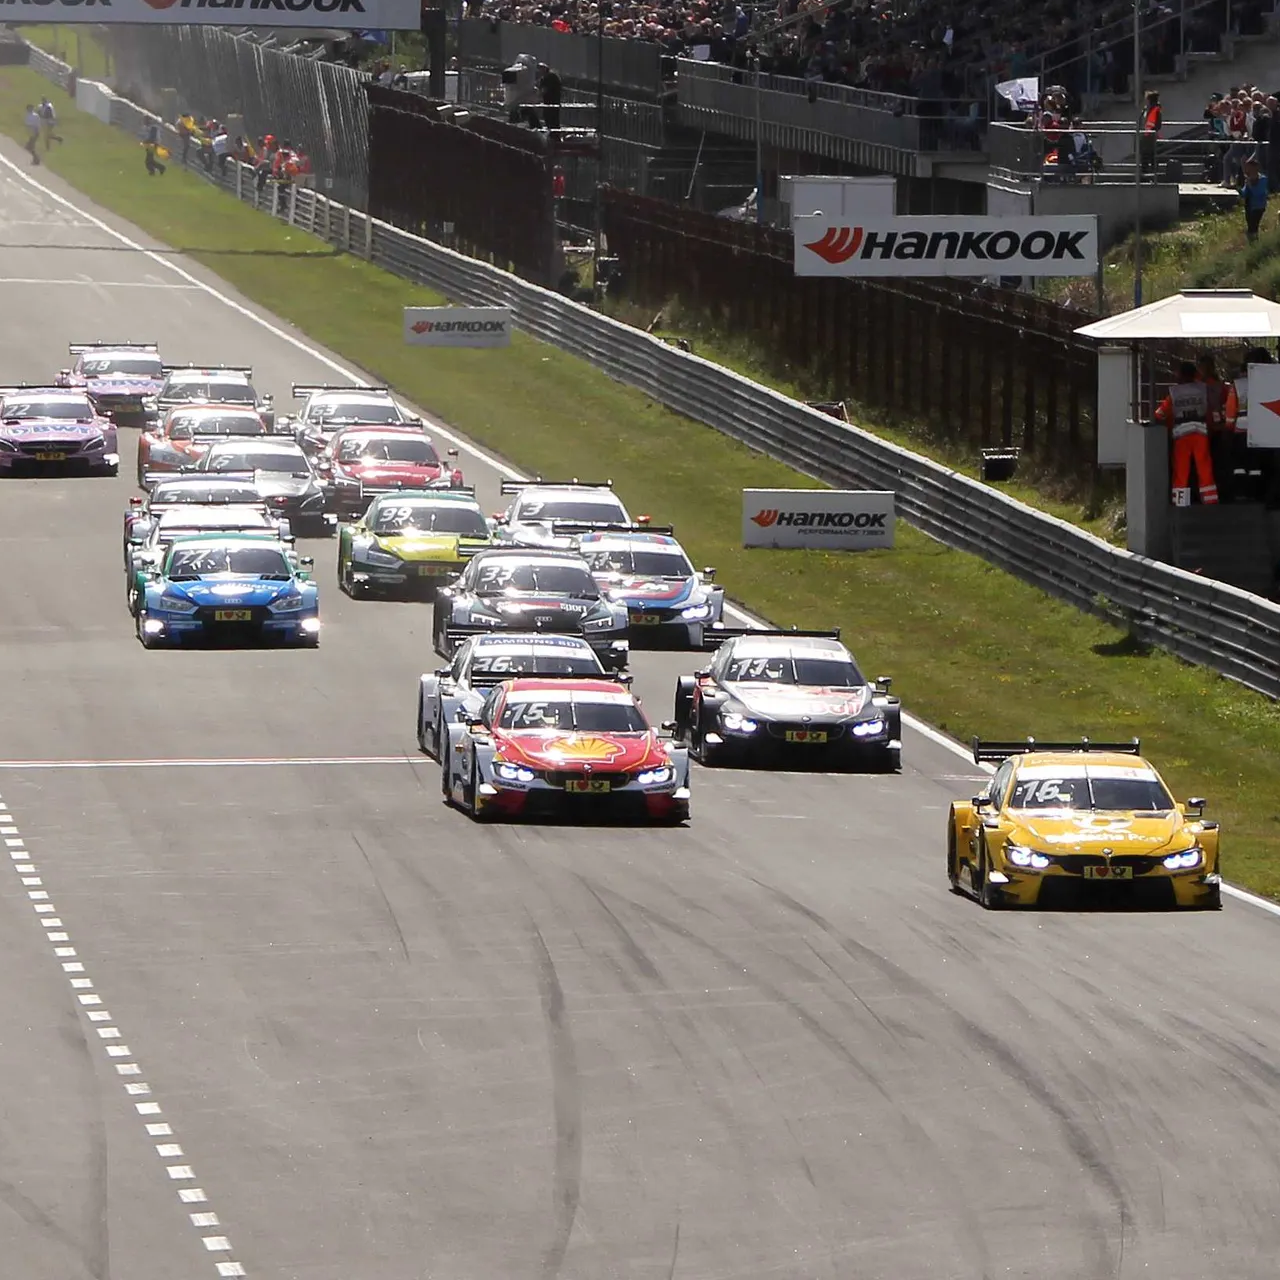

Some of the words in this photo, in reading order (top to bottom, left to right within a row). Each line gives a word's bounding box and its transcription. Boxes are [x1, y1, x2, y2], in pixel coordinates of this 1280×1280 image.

[85, 361, 110, 371] 48
[4, 404, 31, 416] 22
[380, 507, 413, 522] 99
[481, 567, 514, 581] 33
[484, 637, 551, 646] SAMSUNG
[511, 703, 549, 722] 15
[1023, 779, 1063, 803] 16
